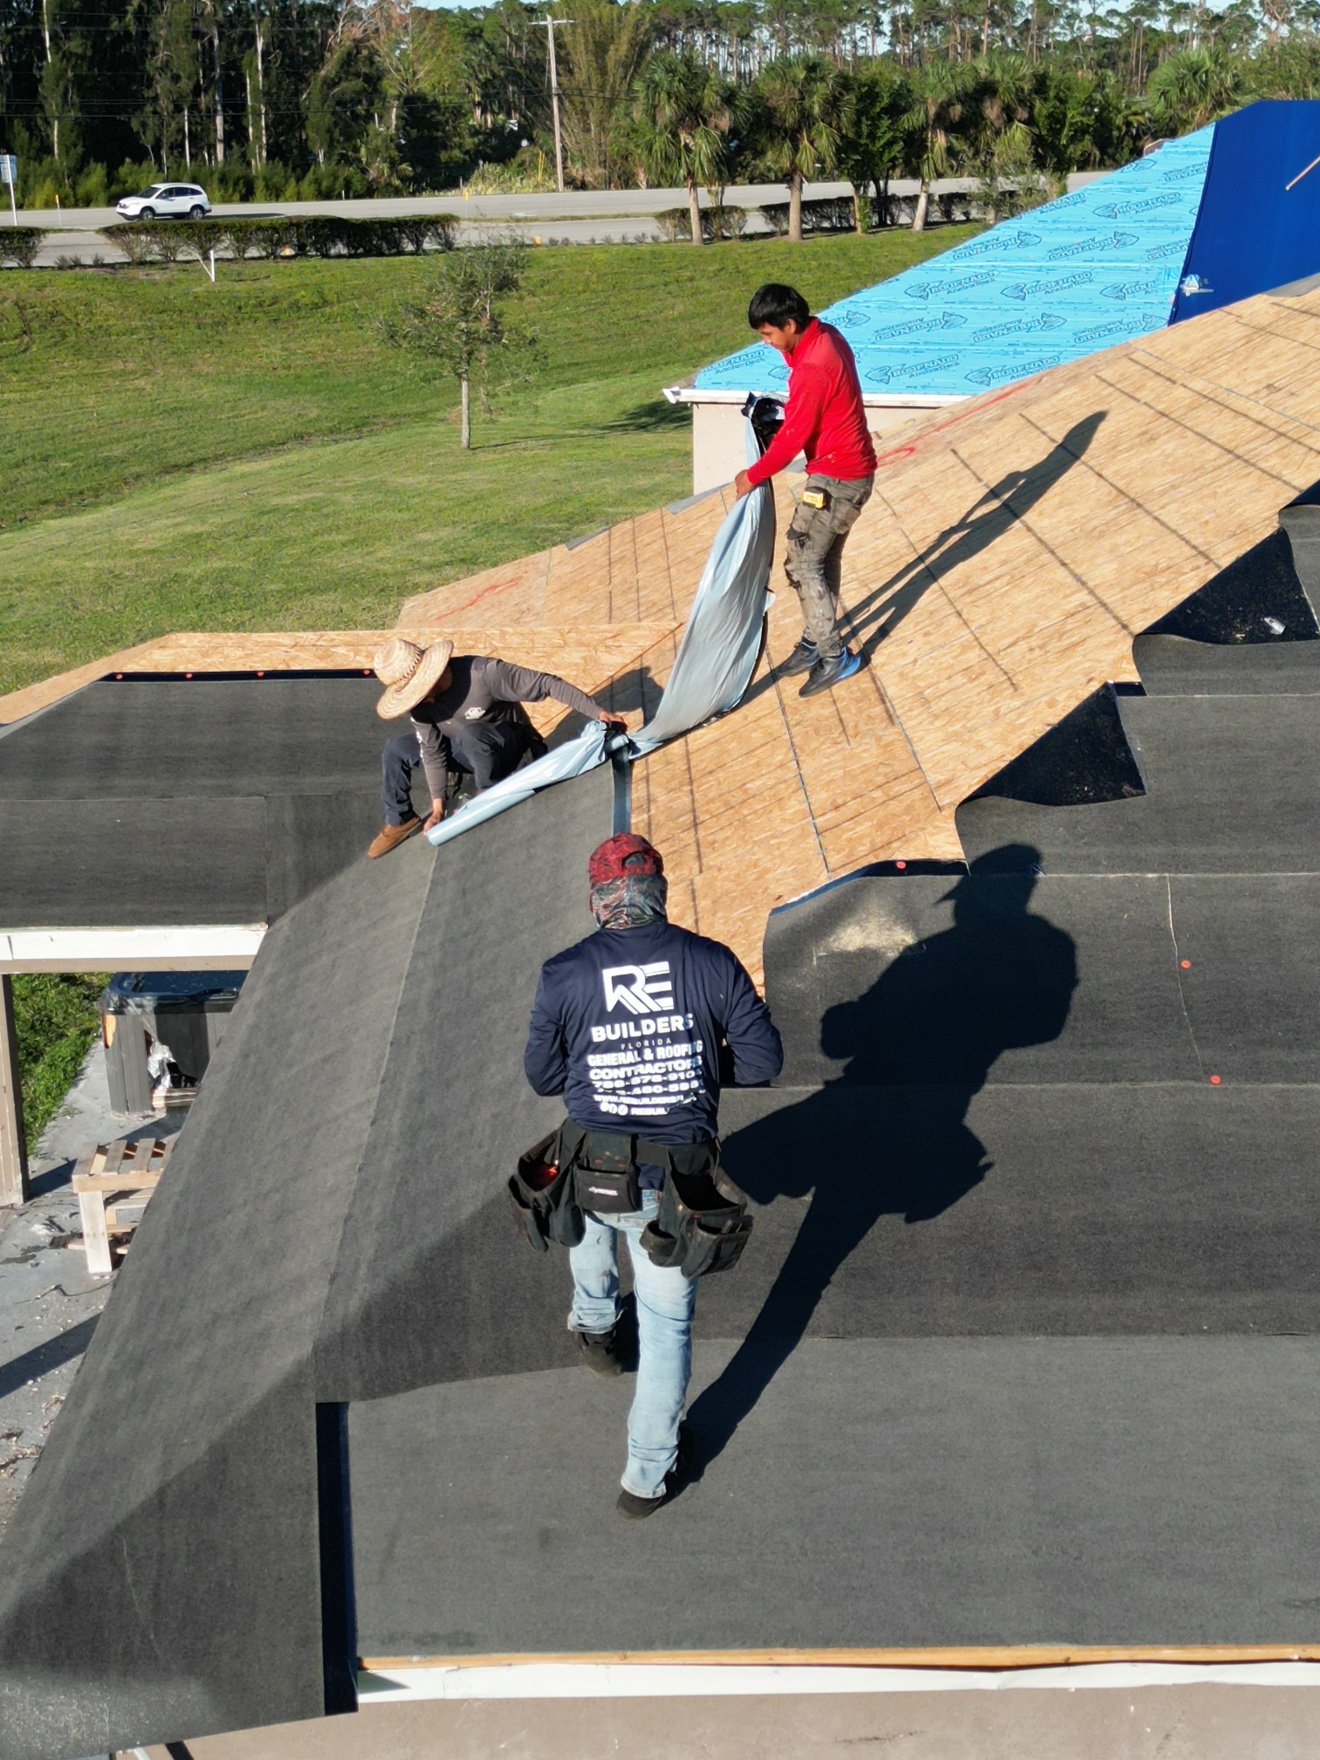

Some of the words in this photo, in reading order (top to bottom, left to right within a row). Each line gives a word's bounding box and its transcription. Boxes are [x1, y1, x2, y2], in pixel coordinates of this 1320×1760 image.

[591, 1013, 694, 1042] BUILDERS
[621, 1038, 671, 1050] FLORIDA
[587, 1050, 641, 1067] GENERAL
[643, 1048, 654, 1061] &
